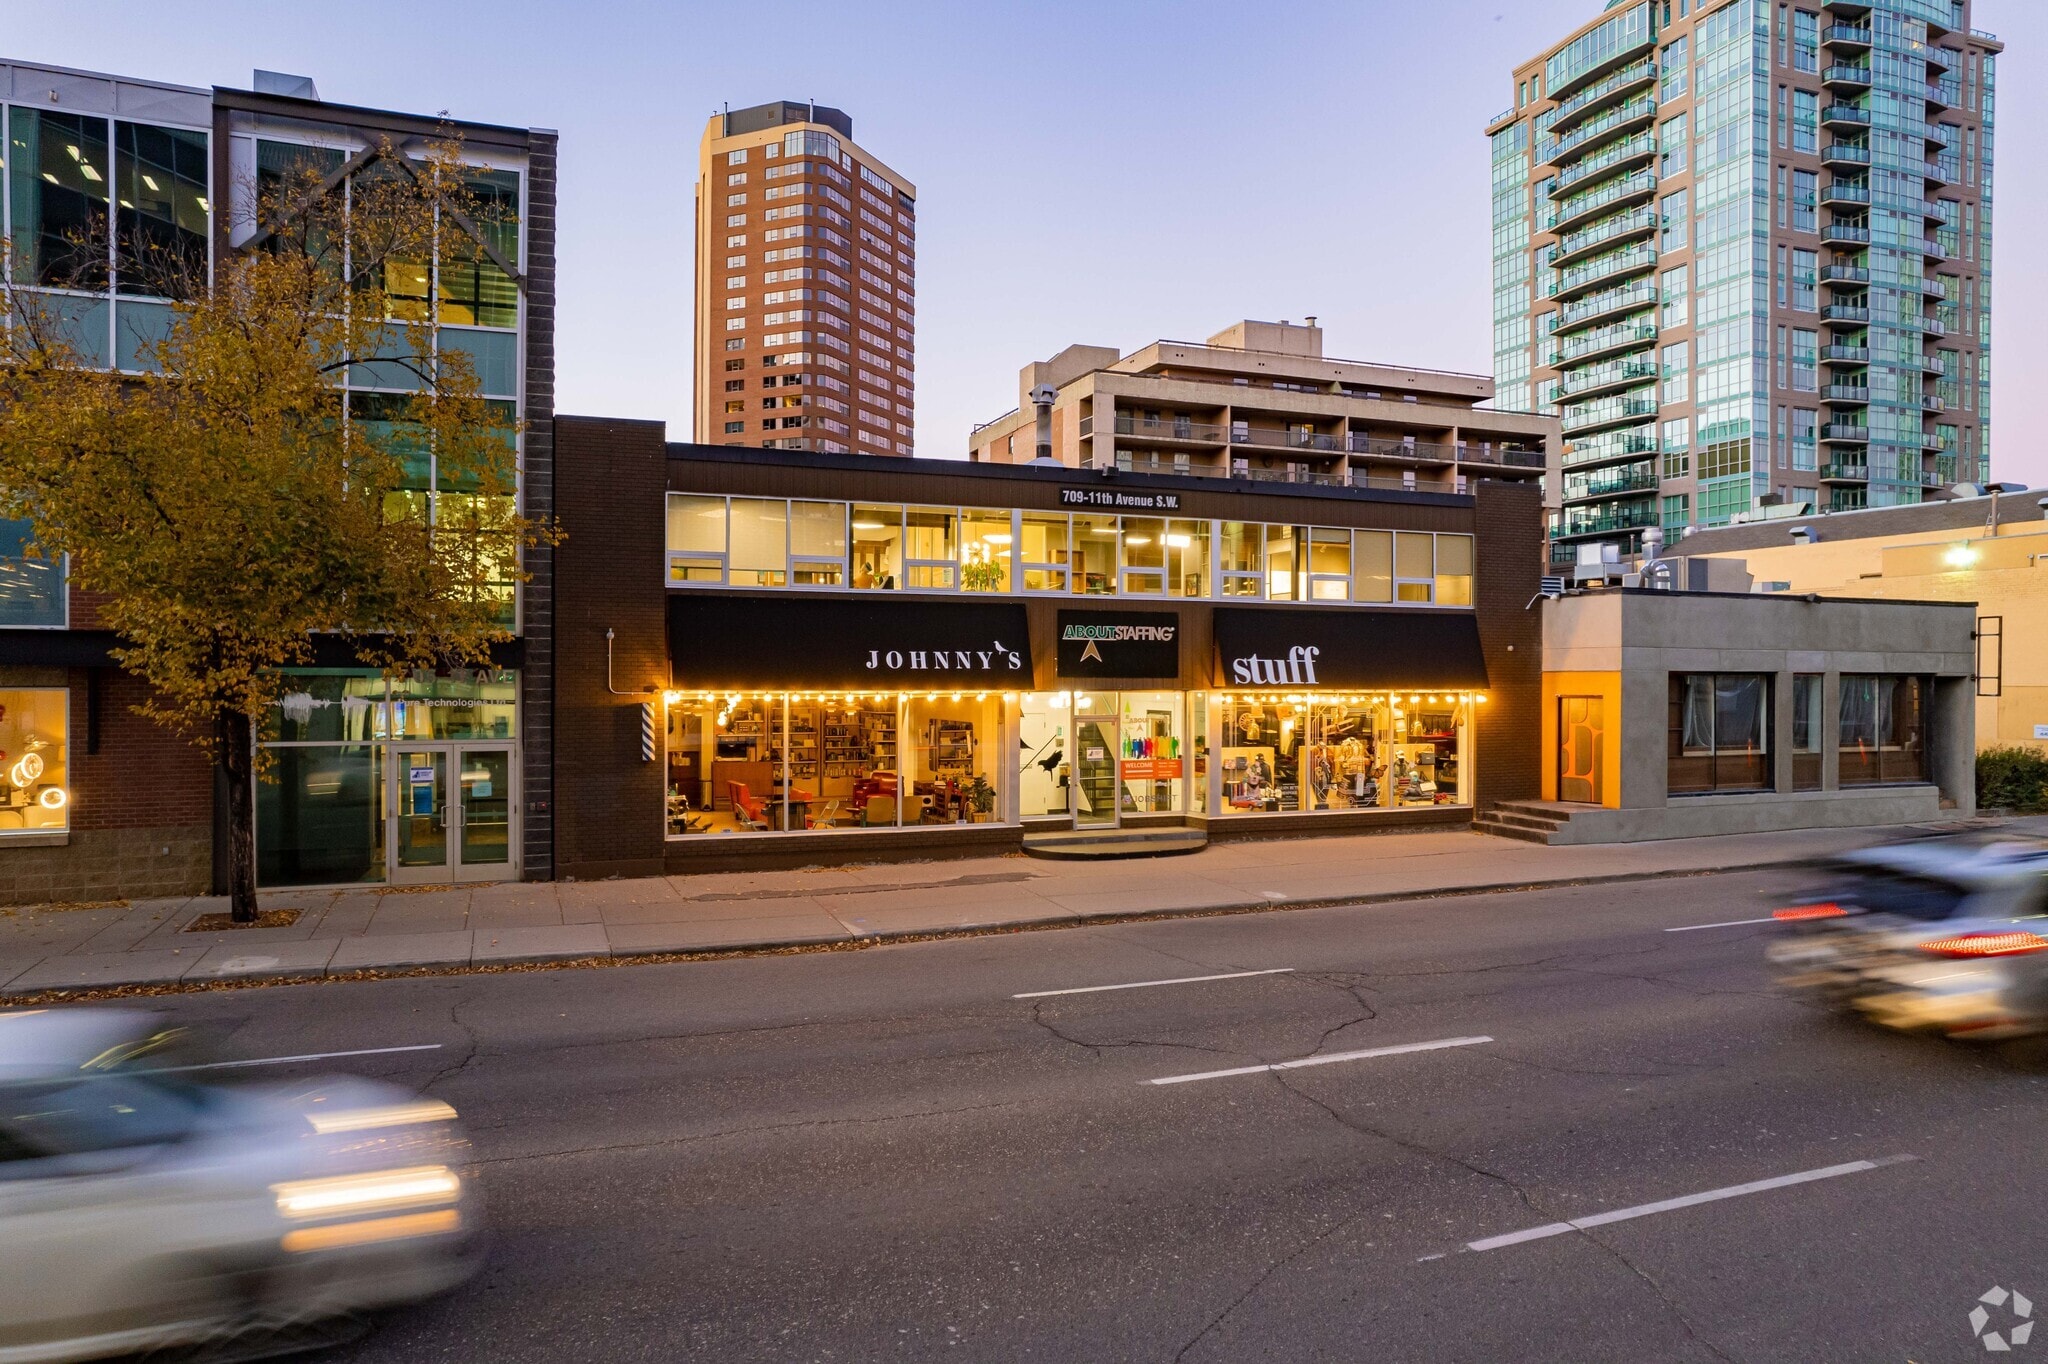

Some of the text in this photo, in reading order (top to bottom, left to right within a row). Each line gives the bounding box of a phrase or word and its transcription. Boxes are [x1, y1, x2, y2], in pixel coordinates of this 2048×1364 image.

[1062, 490, 1179, 508] 709-11th Avenue S.W.
[865, 644, 1022, 670] JOHNNY'S
[1232, 645, 1320, 685] stuff
[476, 668, 515, 684] AVE
[422, 698, 488, 708] Technologies
